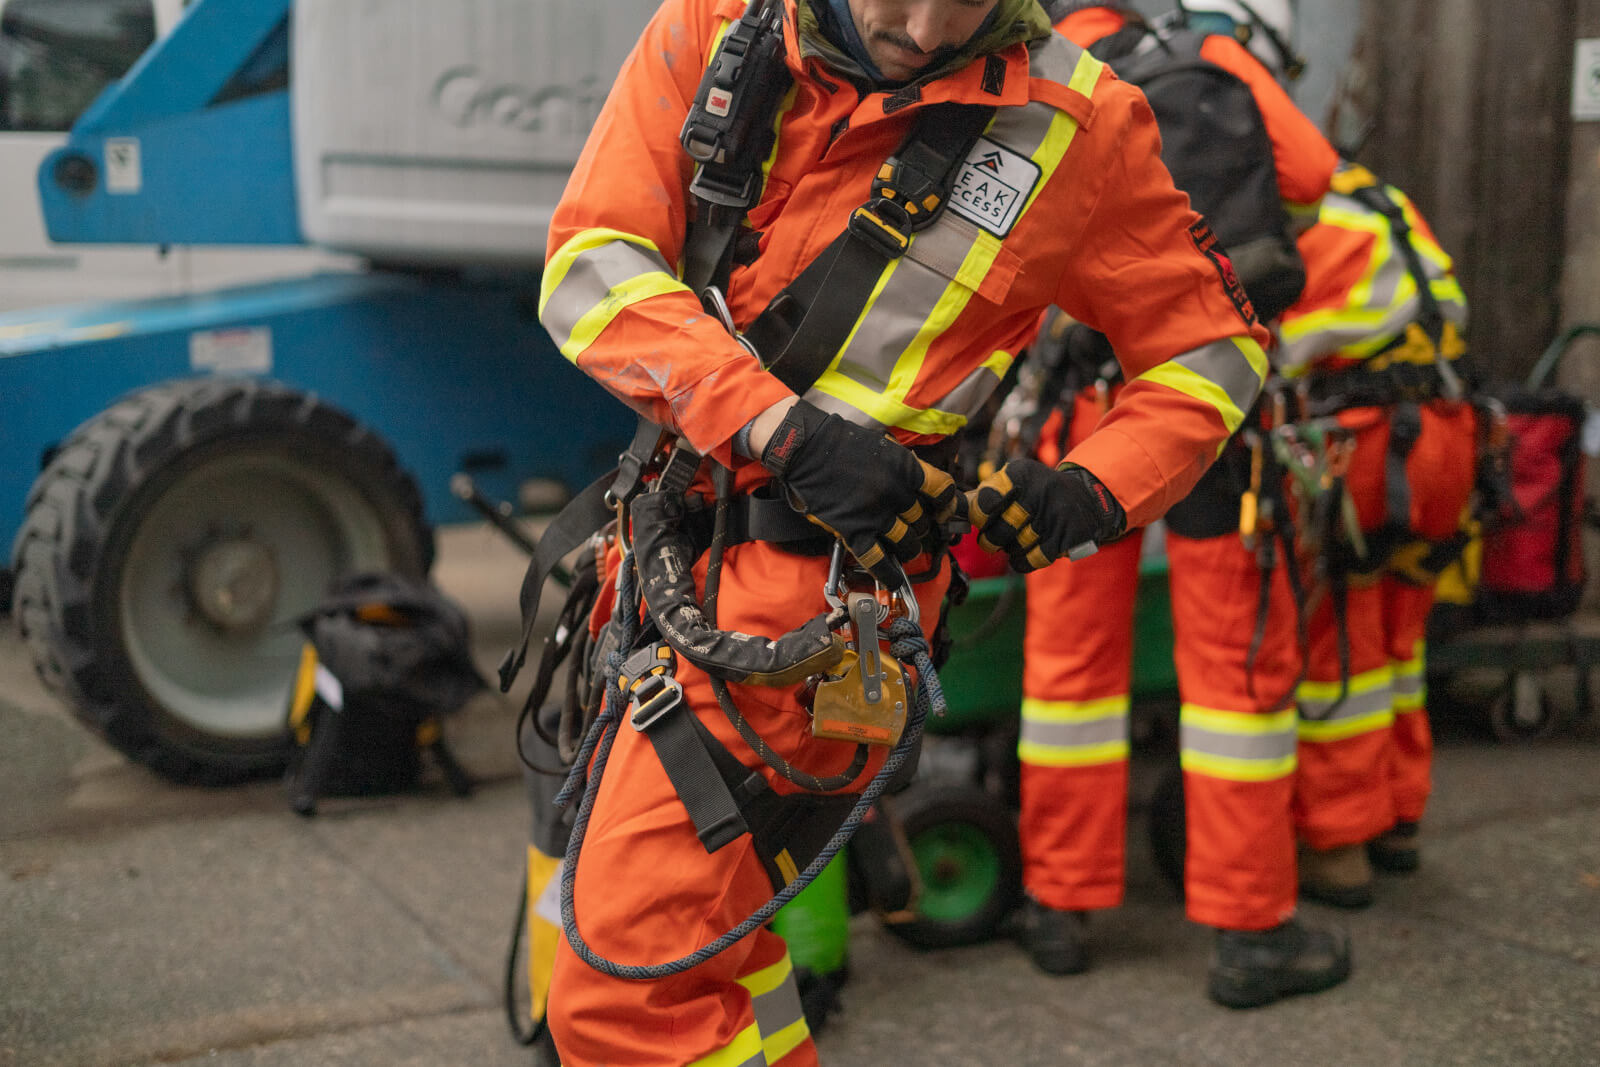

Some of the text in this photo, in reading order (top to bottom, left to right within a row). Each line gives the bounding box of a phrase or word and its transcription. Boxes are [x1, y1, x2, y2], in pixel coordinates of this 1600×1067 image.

[711, 96, 728, 110] 3M
[951, 184, 1001, 217] CCESS
[961, 171, 1009, 206] EAK
